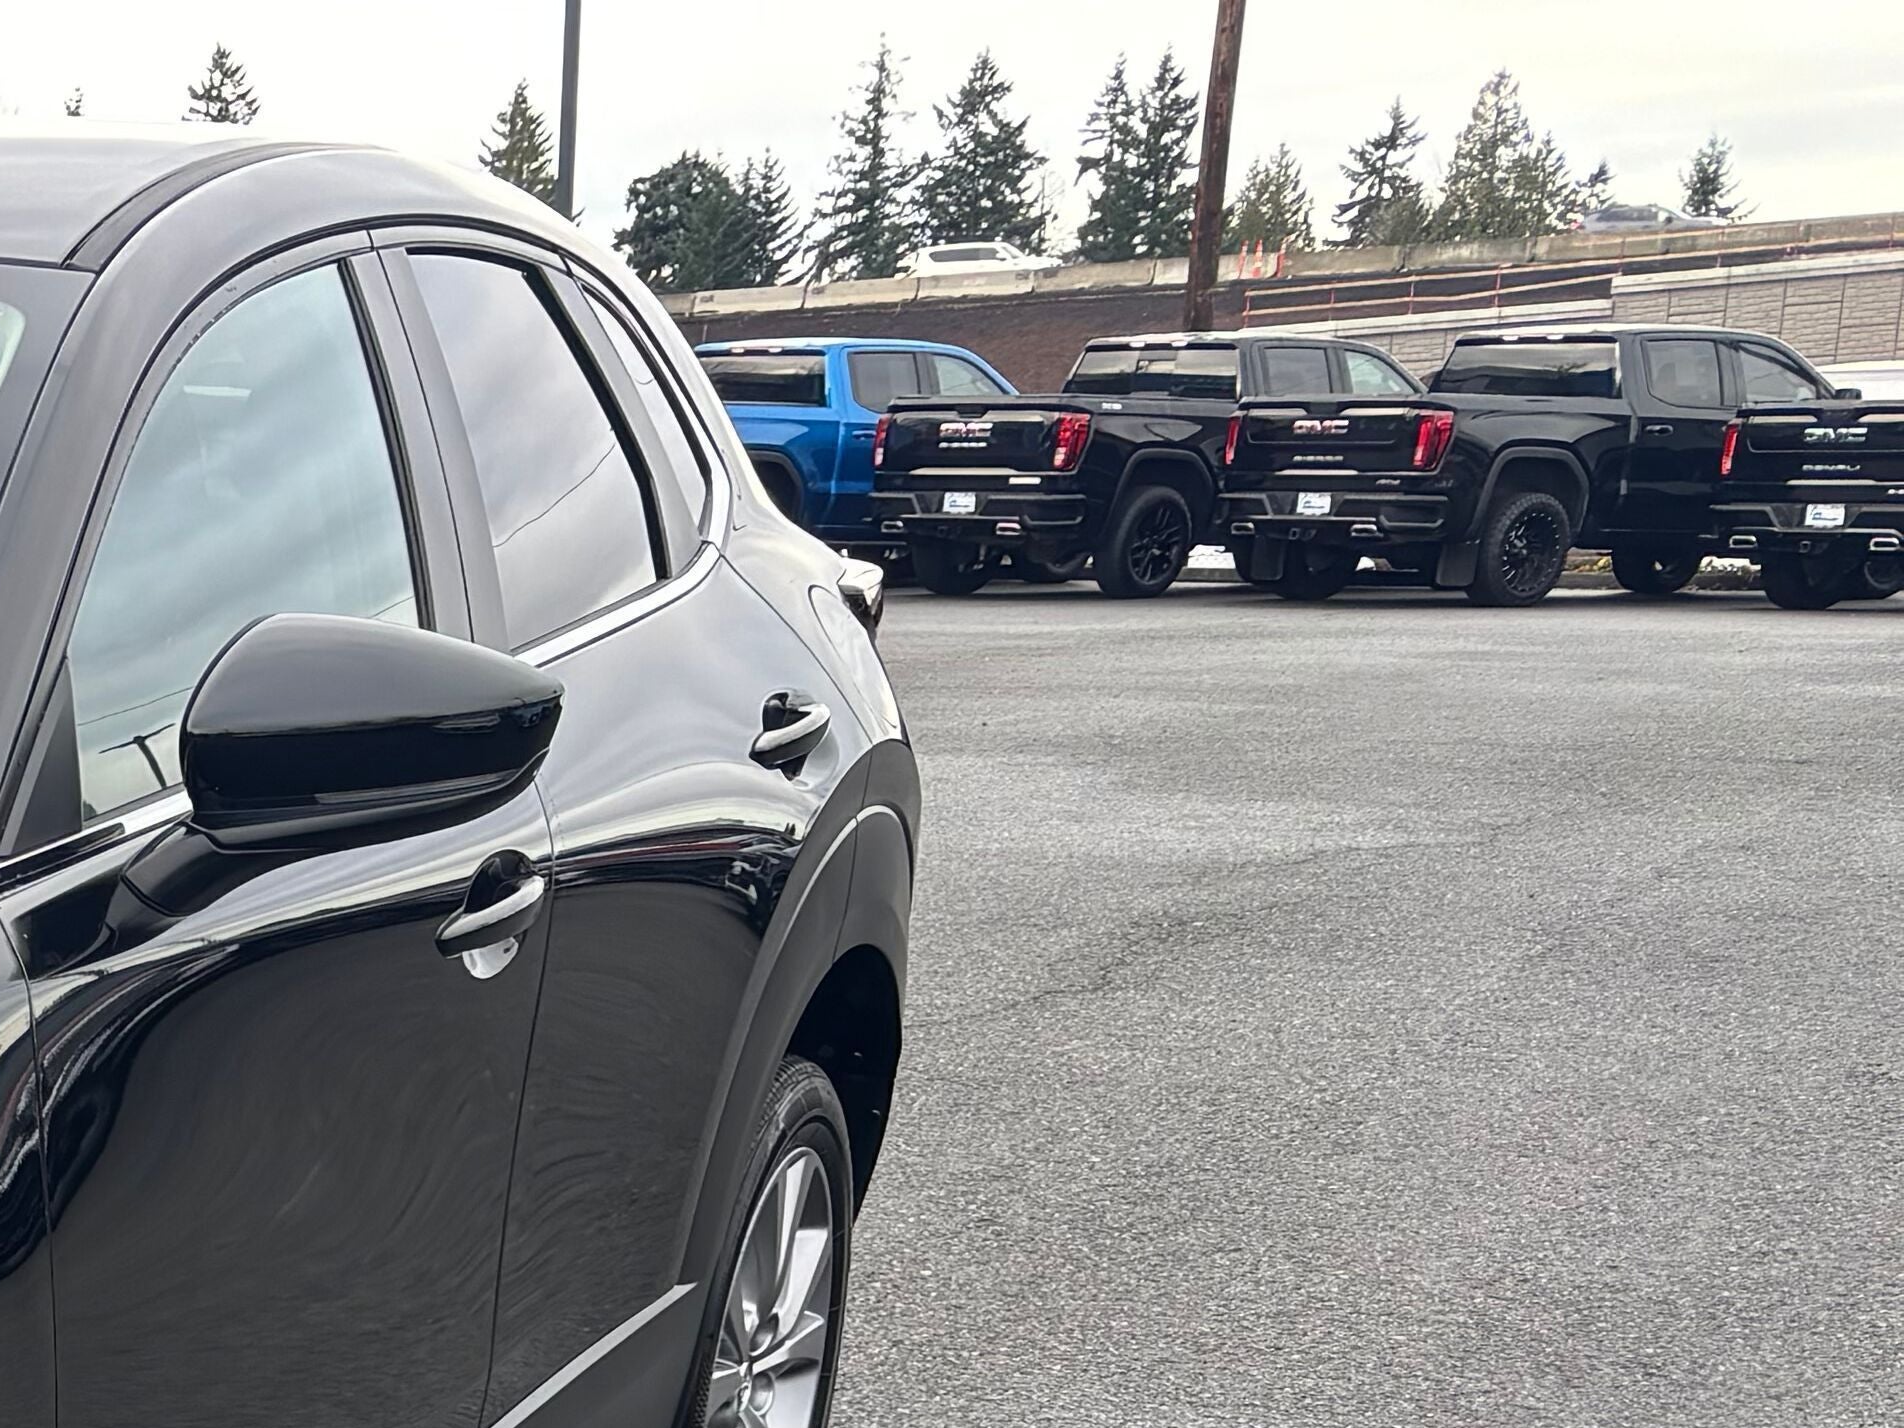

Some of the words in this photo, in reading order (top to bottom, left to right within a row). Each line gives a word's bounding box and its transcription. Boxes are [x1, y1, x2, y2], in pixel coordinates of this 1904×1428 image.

[939, 422, 993, 438] GMC
[1293, 420, 1349, 434] GMC
[1803, 427, 1868, 442] GMC
